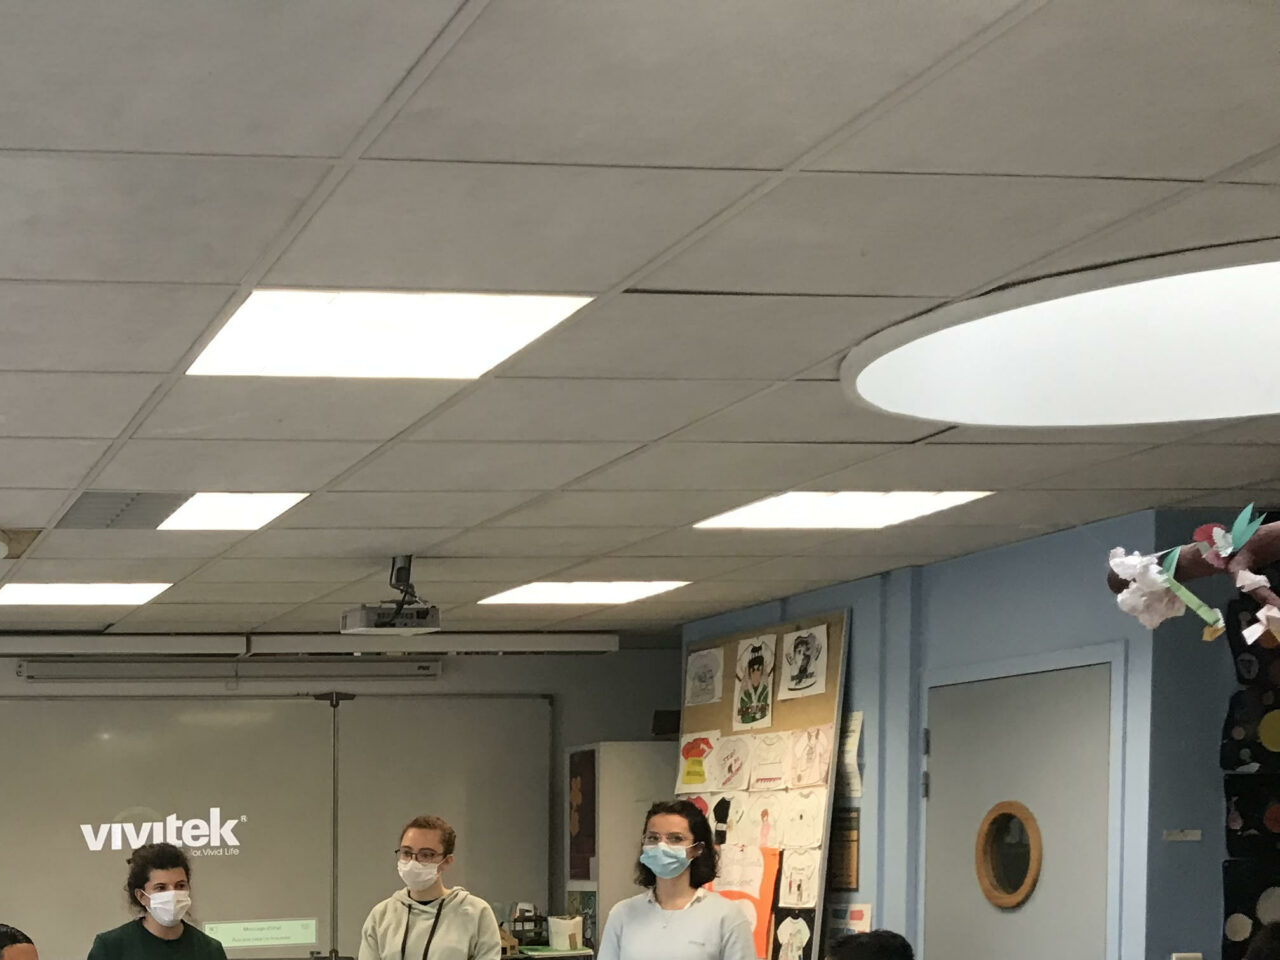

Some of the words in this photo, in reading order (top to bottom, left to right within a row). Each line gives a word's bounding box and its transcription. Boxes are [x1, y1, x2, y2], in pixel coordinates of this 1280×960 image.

[79, 807, 241, 851] vivitek
[203, 848, 224, 856] Vivid
[224, 848, 240, 856] Life
